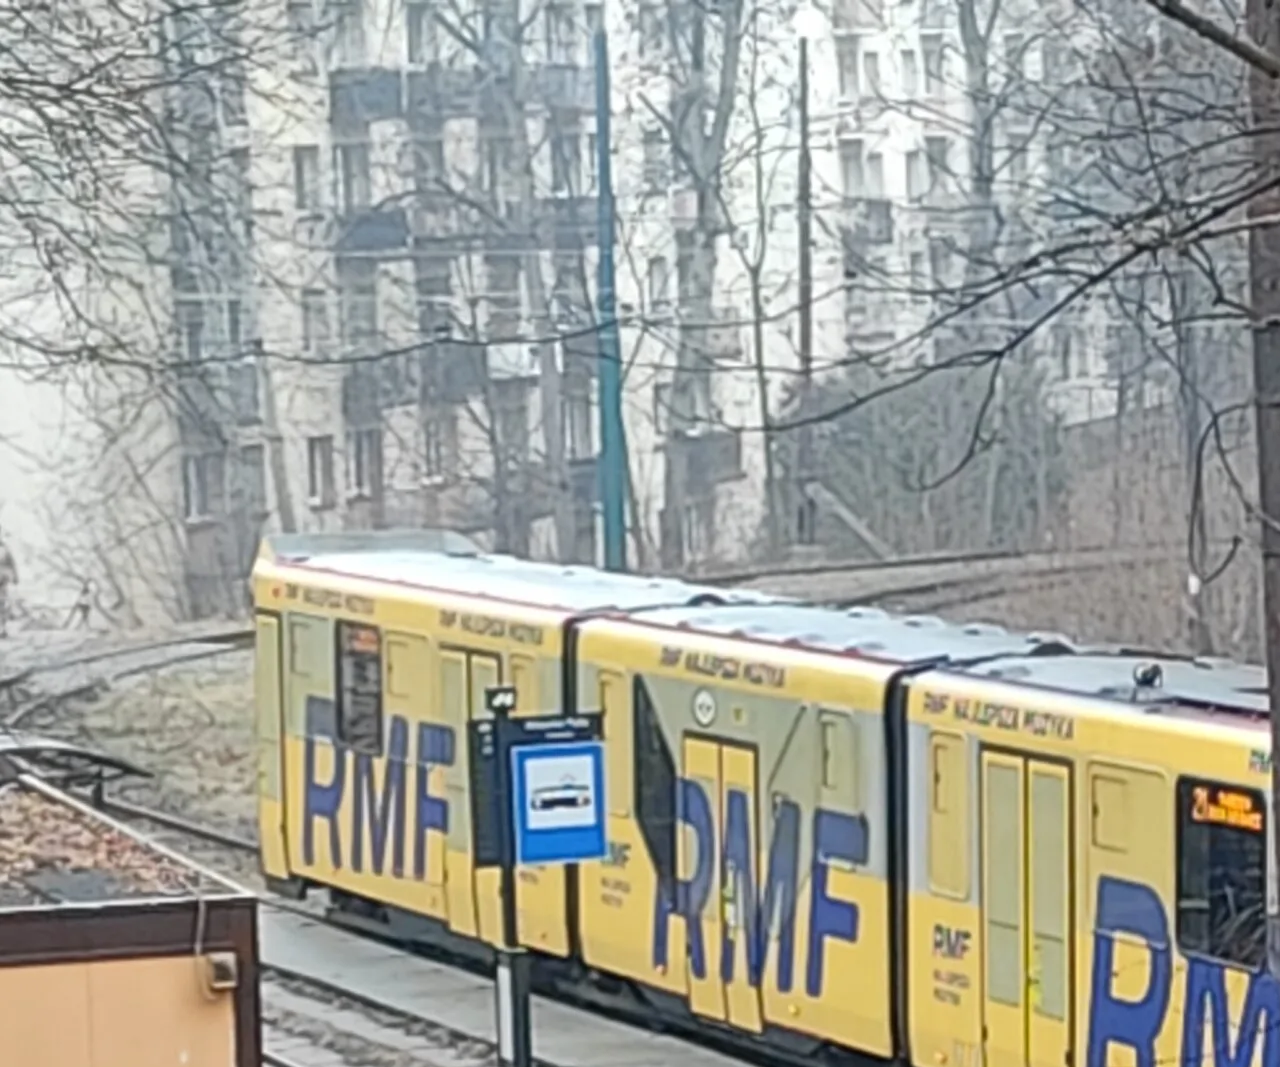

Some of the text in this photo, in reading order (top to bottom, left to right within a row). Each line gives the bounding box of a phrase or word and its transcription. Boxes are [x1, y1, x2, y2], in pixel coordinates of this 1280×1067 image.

[303, 696, 455, 881] RMF
[652, 776, 869, 998] RMF
[933, 923, 972, 960] RMF
